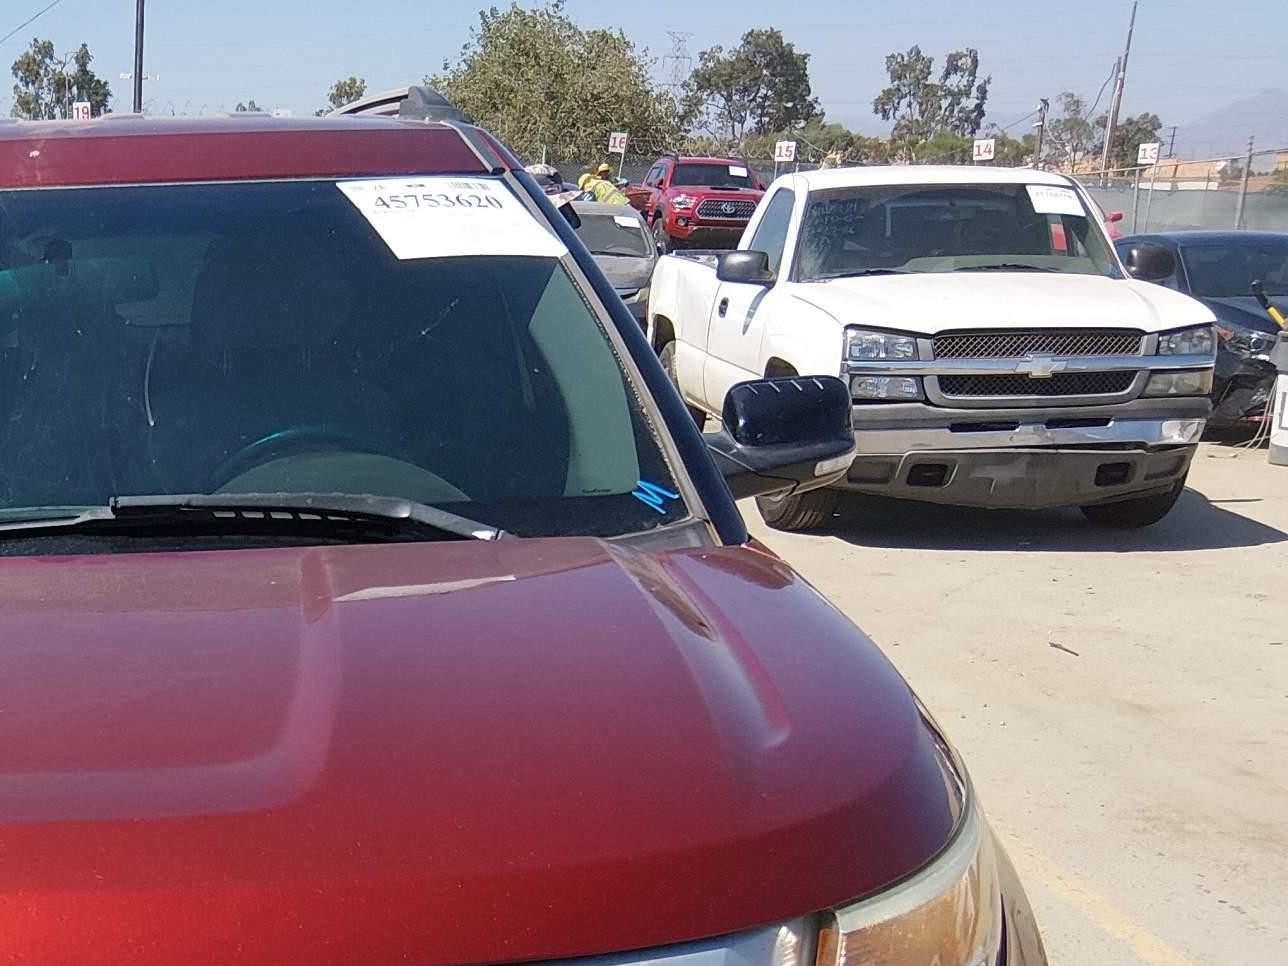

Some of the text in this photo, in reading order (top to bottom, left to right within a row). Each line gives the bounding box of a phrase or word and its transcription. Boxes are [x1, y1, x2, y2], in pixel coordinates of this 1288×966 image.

[74, 105, 90, 120] 19
[776, 145, 793, 158] 15
[974, 143, 993, 157] 14
[374, 193, 504, 209] 45753620
